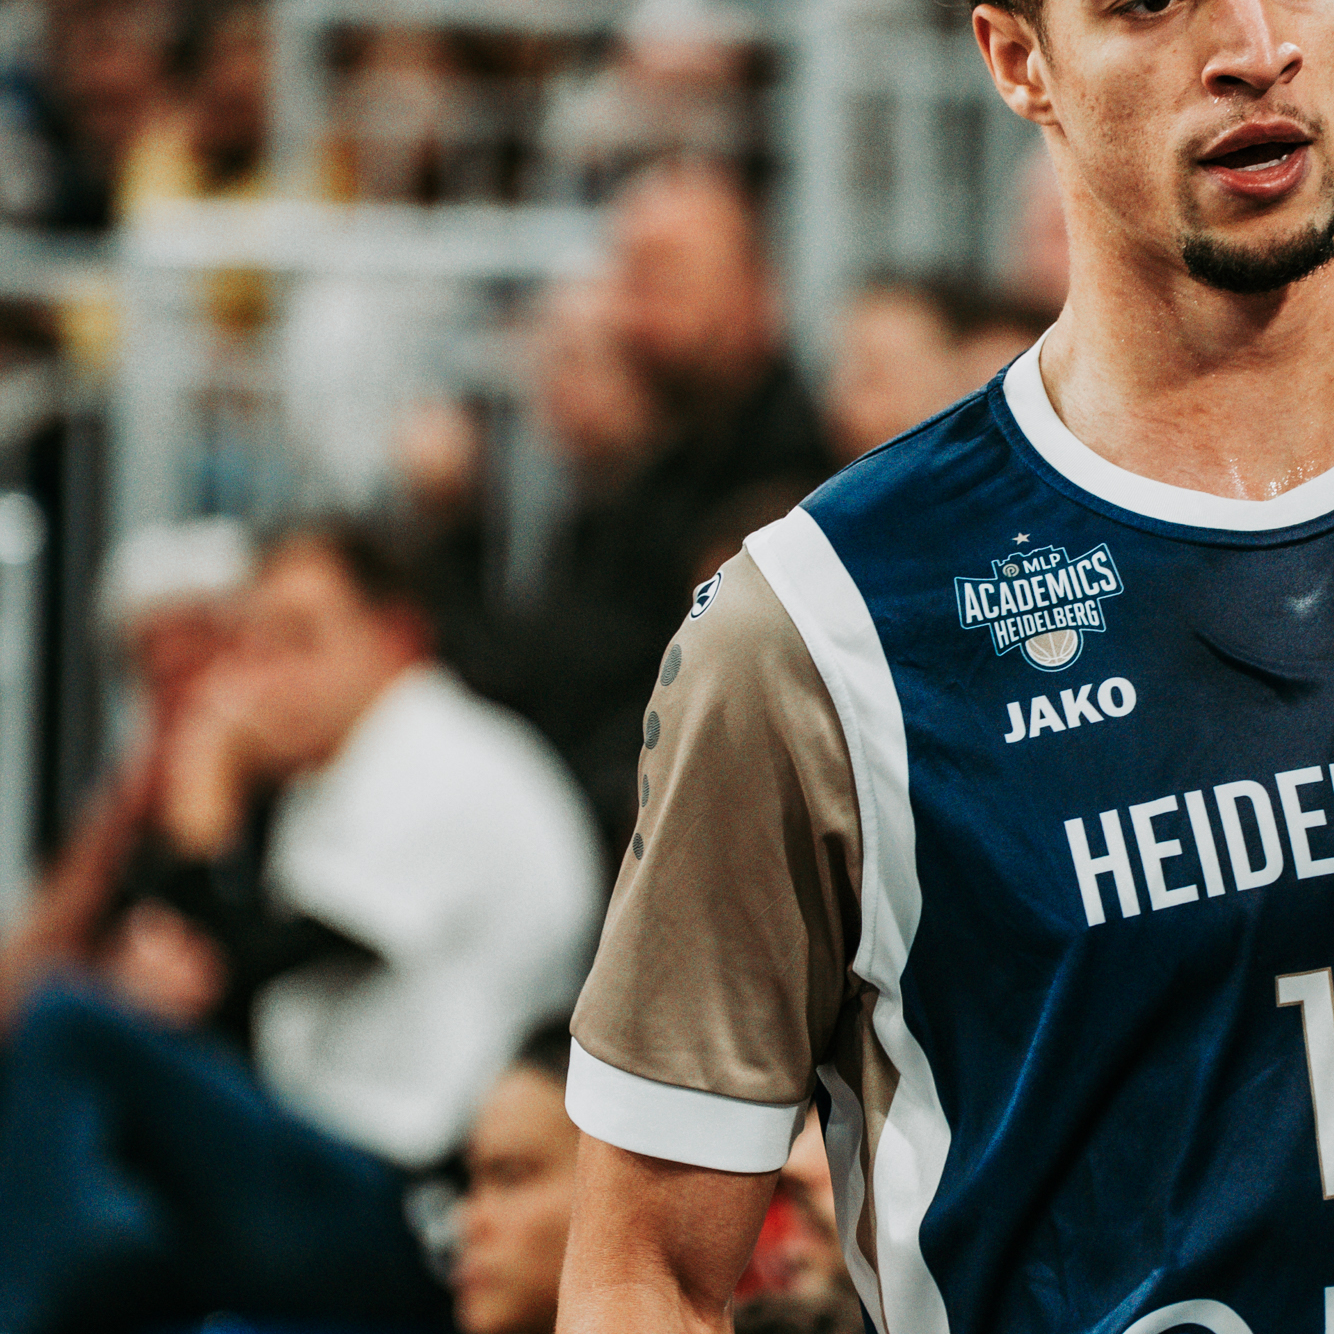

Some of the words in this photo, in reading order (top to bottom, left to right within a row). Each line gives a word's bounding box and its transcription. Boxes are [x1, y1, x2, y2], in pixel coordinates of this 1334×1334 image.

[964, 550, 1118, 624] ACADEMICS
[1022, 553, 1061, 574] MLP
[993, 600, 1100, 649] HEIDELBERG
[1004, 676, 1138, 744] JAKO
